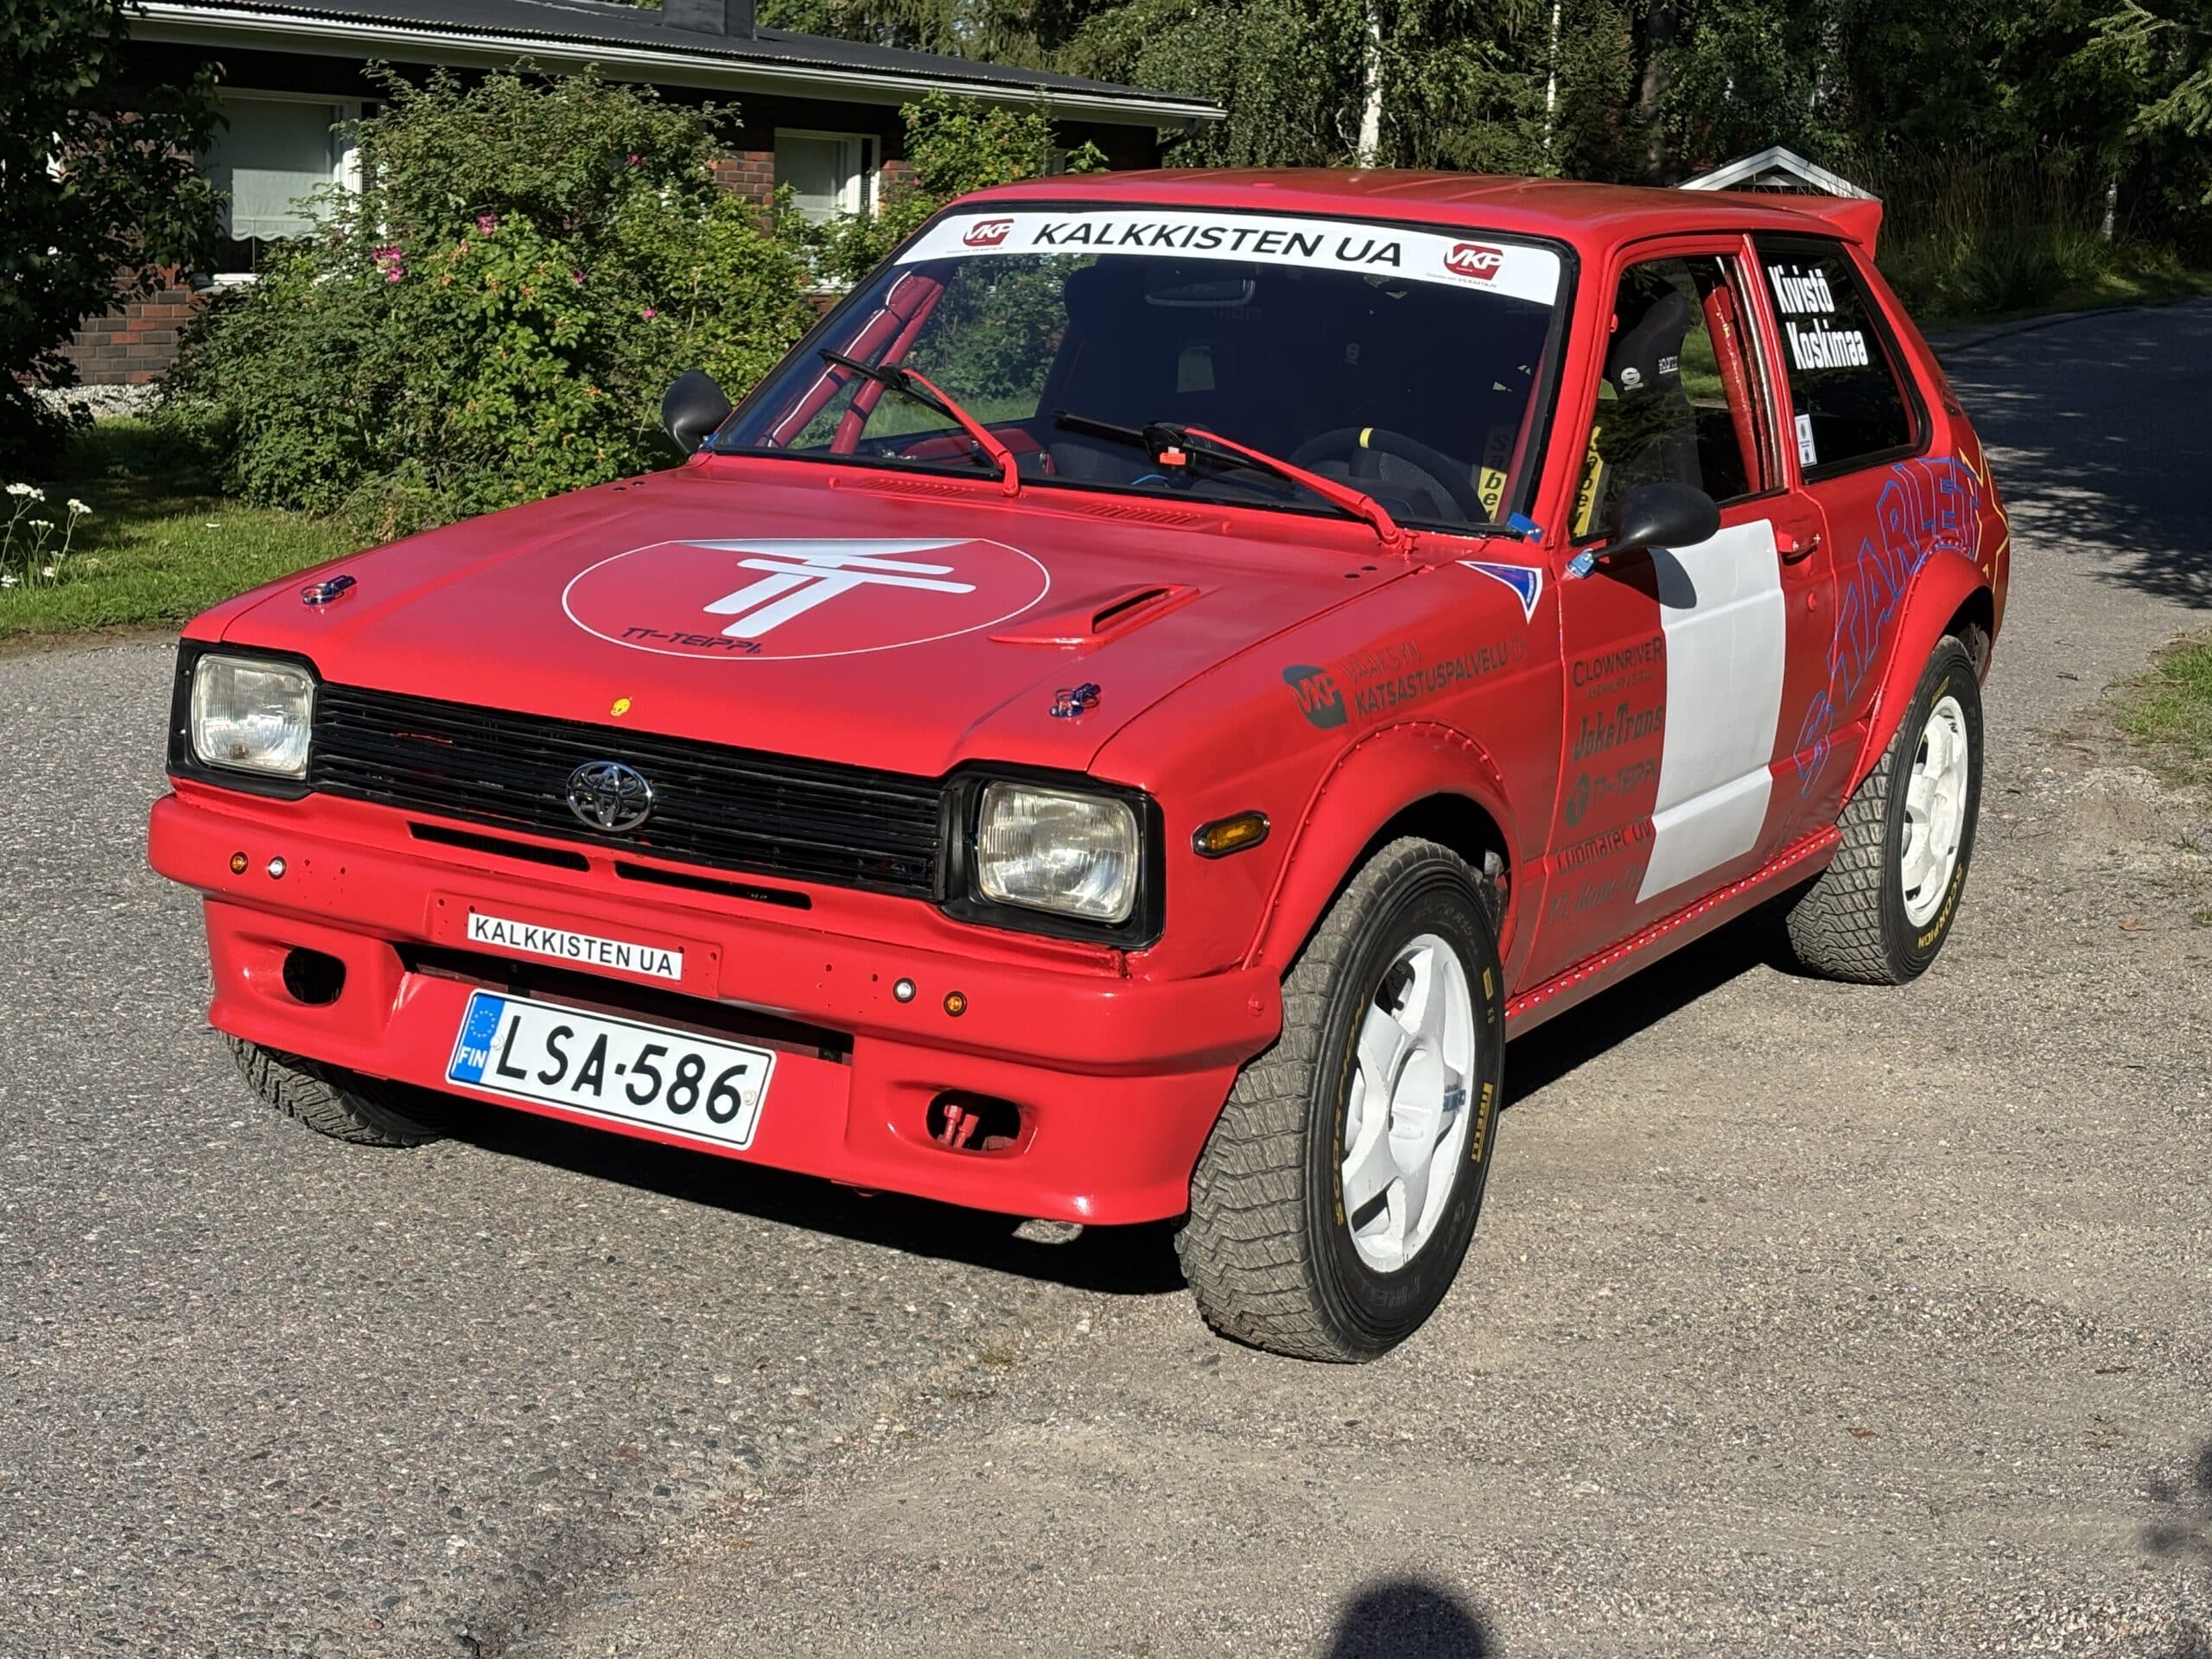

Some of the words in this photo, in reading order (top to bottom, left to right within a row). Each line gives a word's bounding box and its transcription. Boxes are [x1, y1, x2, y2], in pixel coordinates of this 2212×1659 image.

[1032, 222, 1324, 257] KALKKISTEN
[1335, 238, 1402, 267] UA
[1768, 264, 1835, 313] Kivistö
[1785, 318, 1868, 369] Koskimaa
[622, 626, 763, 654] TT-TEIPPI
[1355, 642, 1507, 717] KATSASTUSPALVELU
[1917, 863, 1962, 949] SCORPION
[475, 917, 631, 968] KALKKISTEN
[639, 949, 673, 976] UA
[457, 1046, 488, 1069] FIN
[496, 1015, 748, 1123] LSA-586
[1471, 1083, 1493, 1162] PIRELLI
